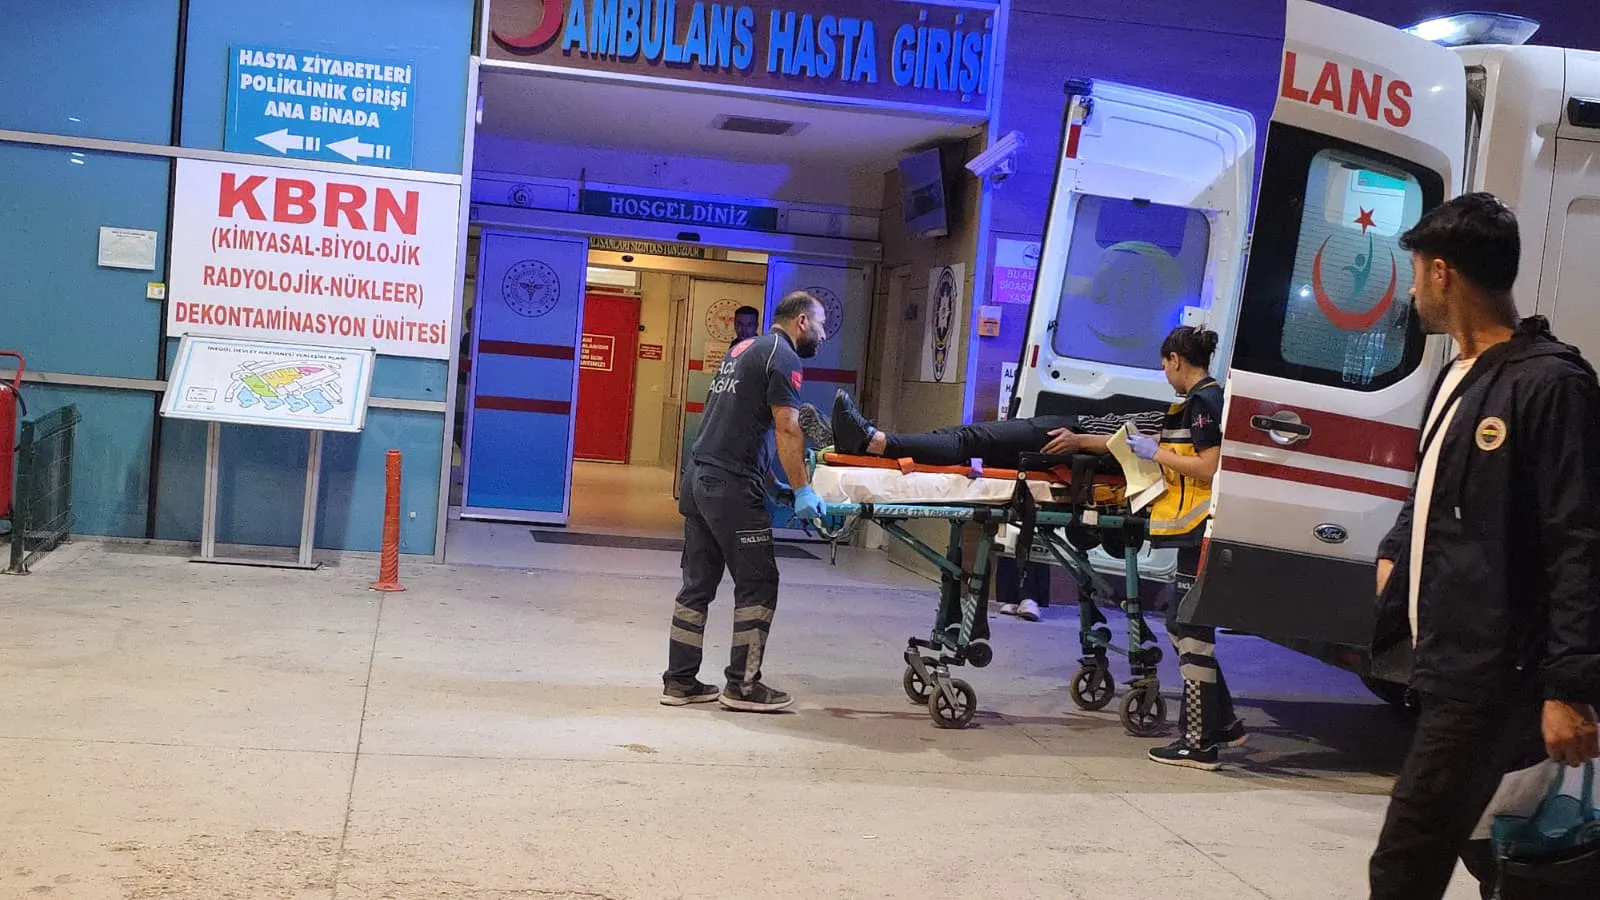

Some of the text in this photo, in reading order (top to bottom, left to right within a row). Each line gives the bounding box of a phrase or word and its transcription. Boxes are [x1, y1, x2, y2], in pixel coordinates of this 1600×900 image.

[239, 49, 411, 84] HASTA ZİYARETLERİ
[562, 0, 992, 102] AMBULANS HASTA GİRİŞİ
[240, 73, 407, 111] POLİKLİNİK GİRİŞİ
[1281, 51, 1412, 127] LANS
[264, 101, 380, 128] ANA BİNADA
[218, 172, 420, 235] KBRN
[211, 224, 420, 266] (KİMYASAL-BİYOLOJİK
[203, 265, 424, 309] RADYOLOJİK-NÜKLEER)
[175, 301, 446, 344] DEKONTAMİNASYON ÜNİTESİ
